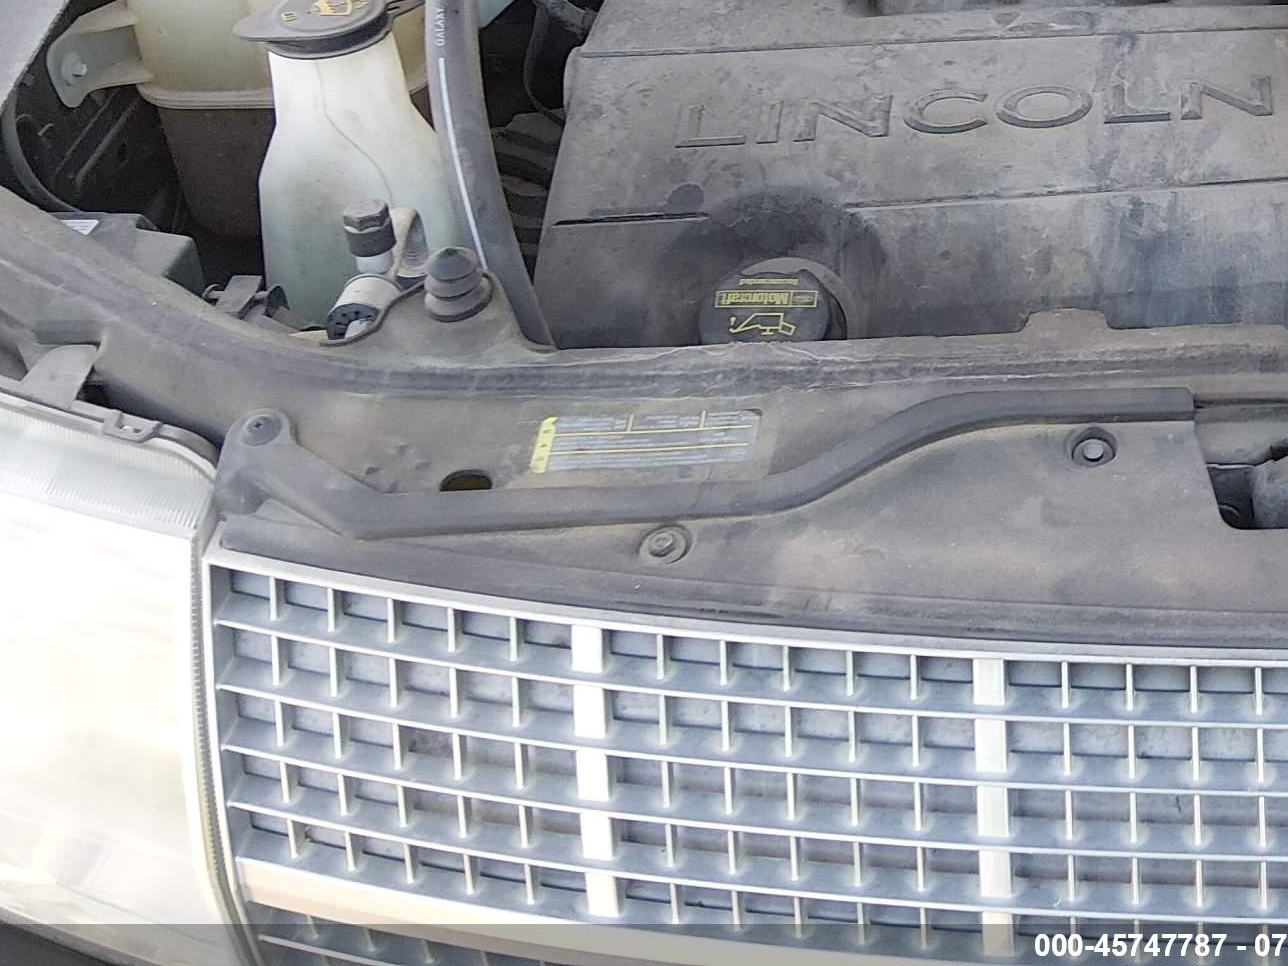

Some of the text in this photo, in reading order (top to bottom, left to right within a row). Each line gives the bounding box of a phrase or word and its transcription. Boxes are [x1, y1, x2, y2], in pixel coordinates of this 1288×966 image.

[434, 7, 446, 47] GALAXY
[675, 75, 1273, 148] LINCOLN
[719, 292, 789, 305] Motorcraft
